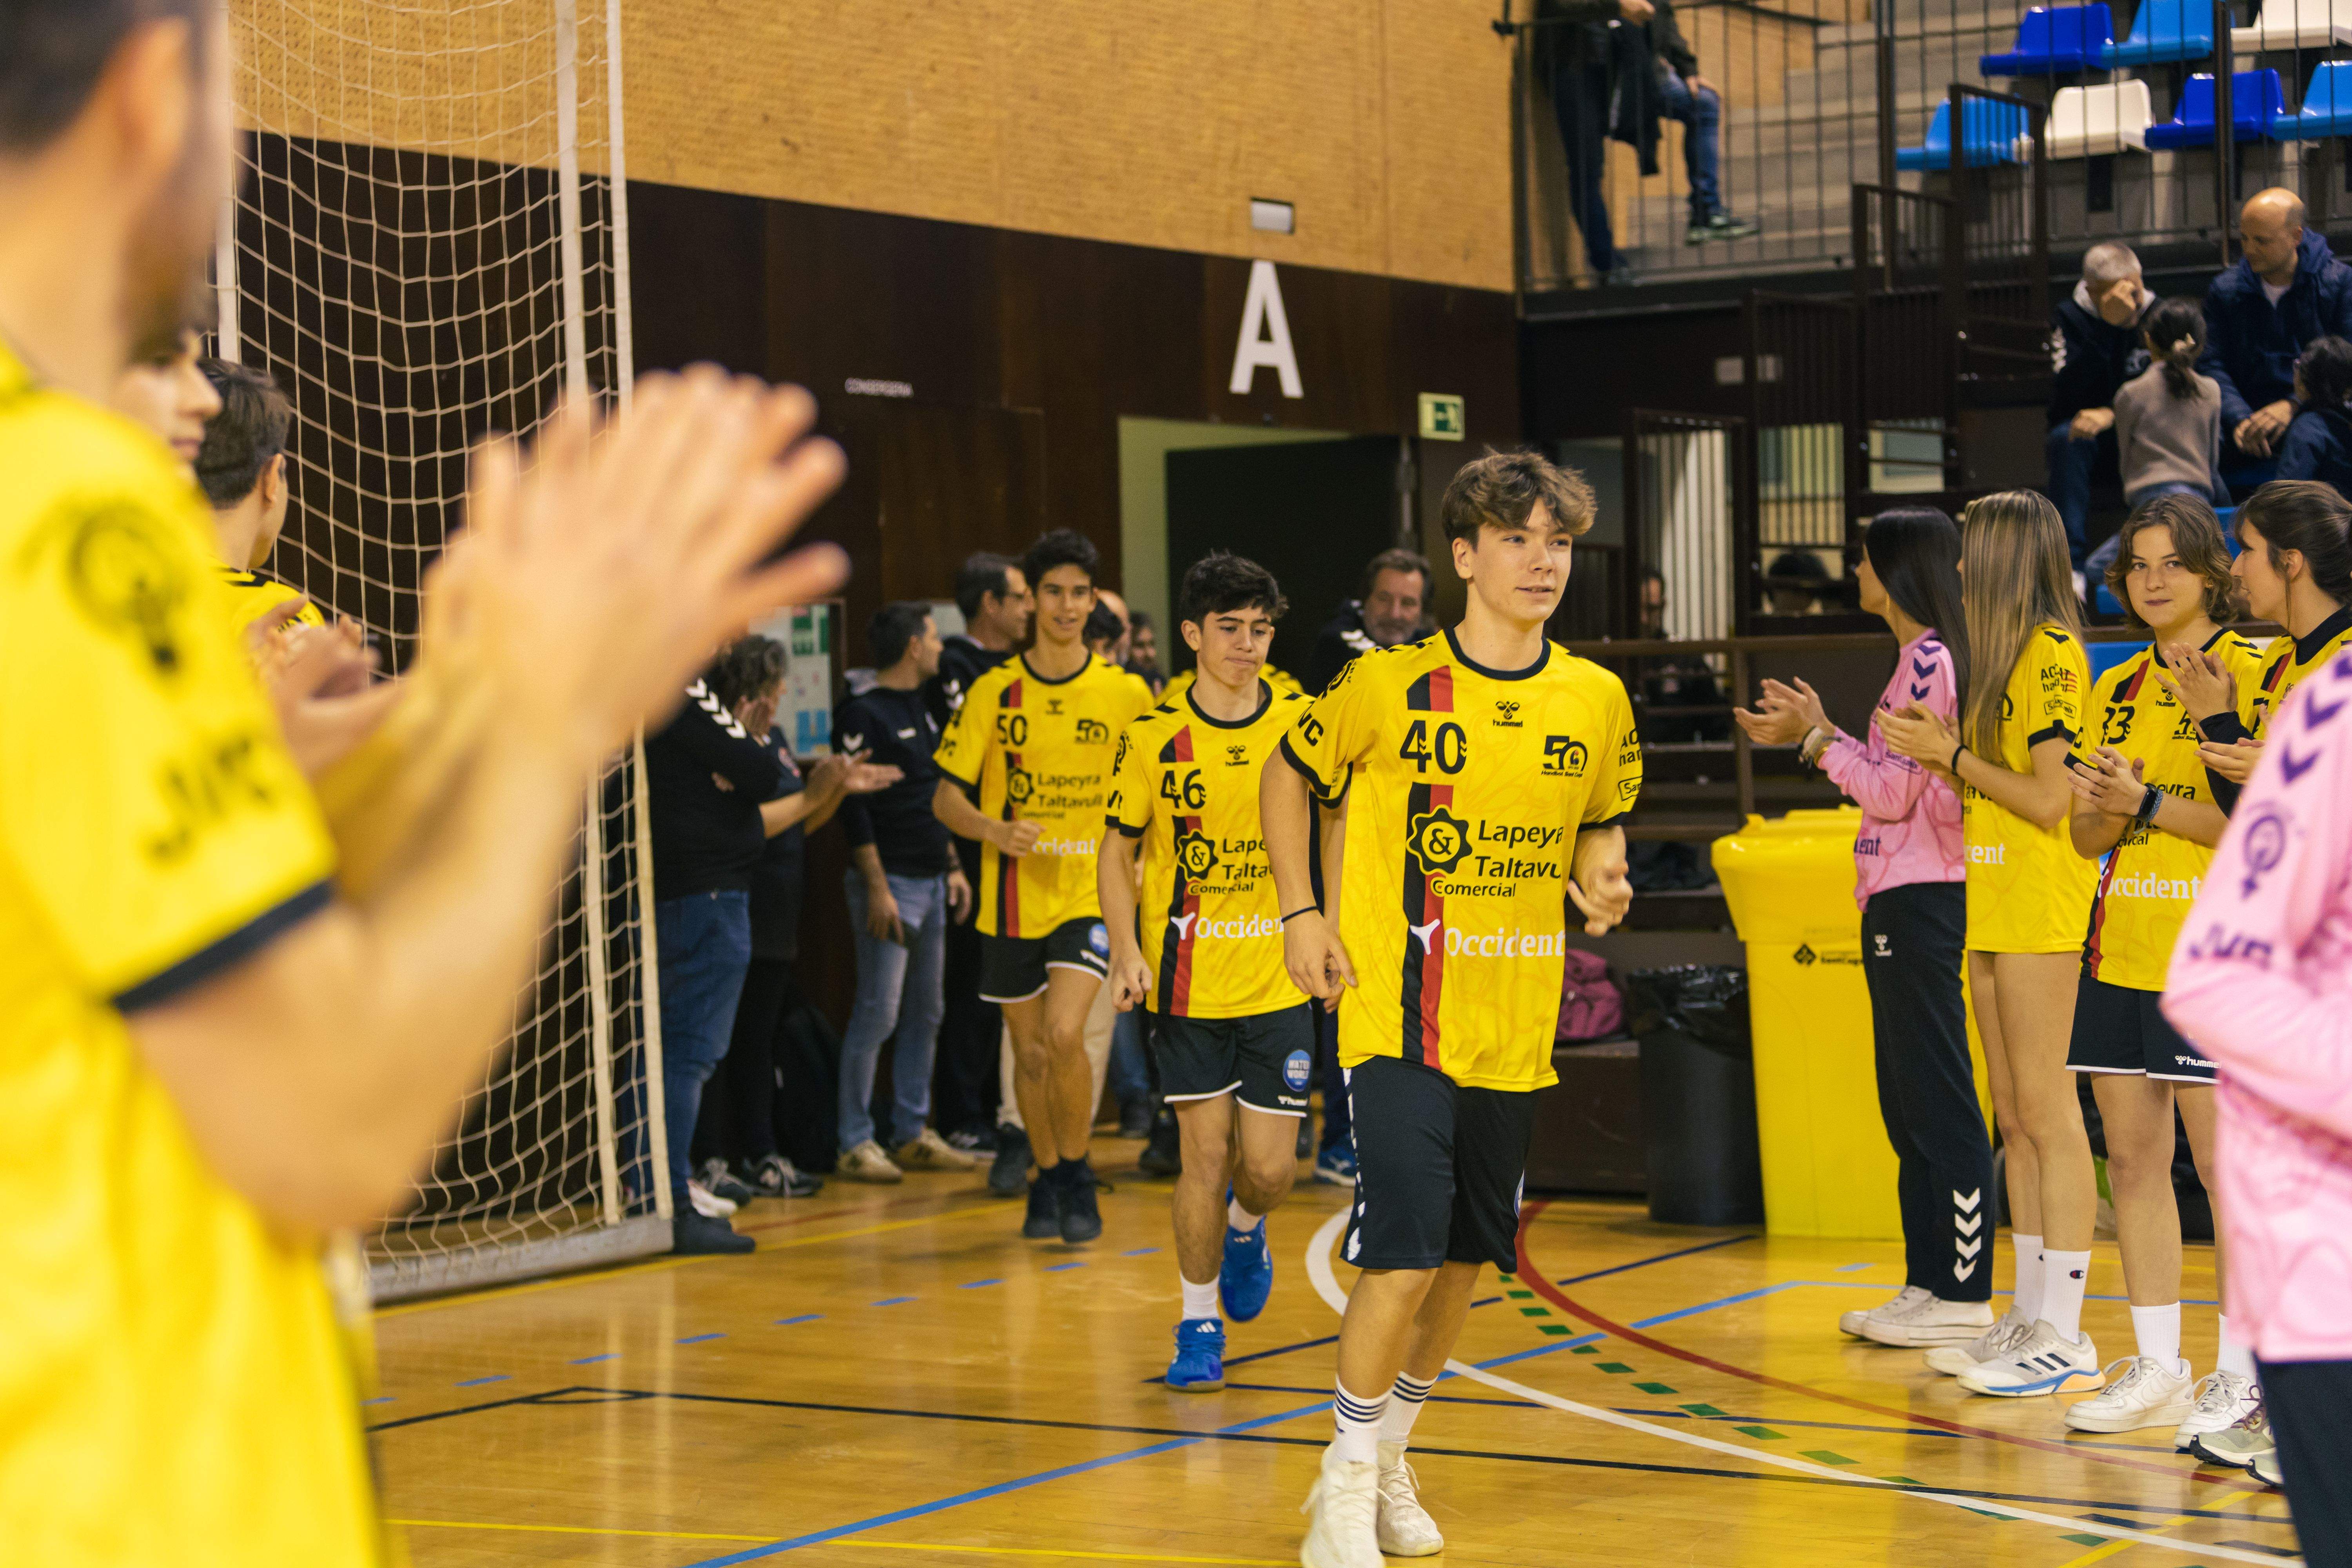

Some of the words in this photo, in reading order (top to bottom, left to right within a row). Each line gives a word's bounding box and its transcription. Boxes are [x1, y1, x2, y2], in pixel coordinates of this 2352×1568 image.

[1229, 260, 1304, 399] A
[997, 714, 1027, 746] 50
[1297, 712, 1324, 747] VC
[1493, 719, 1523, 727] hummel
[1399, 720, 1468, 775] 40
[1160, 768, 1207, 809] 46
[1032, 837, 1095, 856] ccident
[1223, 838, 1267, 857] Lape
[1475, 856, 1561, 878] Taltavu
[1433, 880, 1517, 897] Comercial
[1194, 914, 1285, 939] Occiden
[1444, 927, 1566, 958] Occident
[2186, 1056, 2220, 1069] humme
